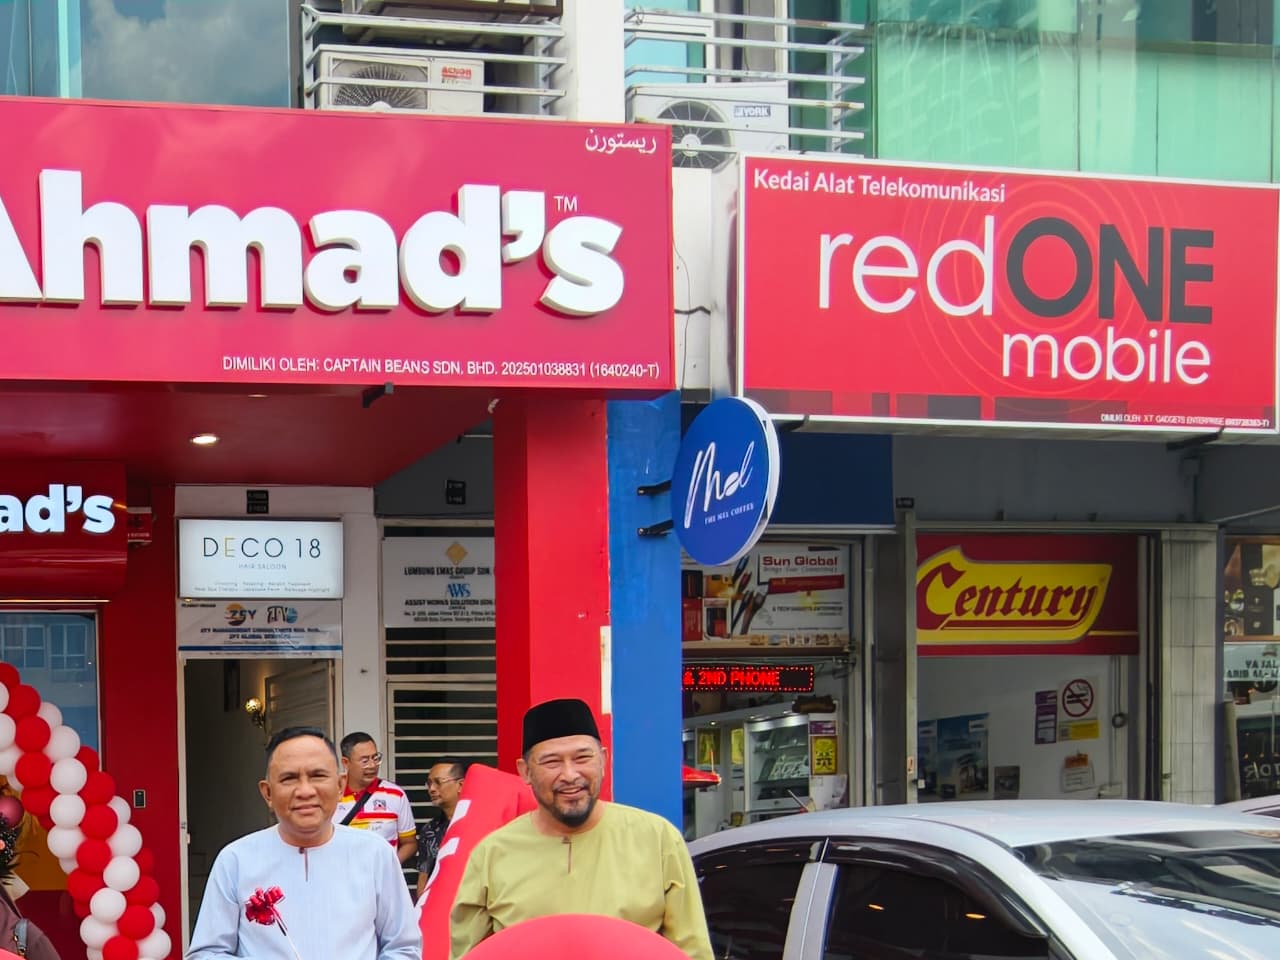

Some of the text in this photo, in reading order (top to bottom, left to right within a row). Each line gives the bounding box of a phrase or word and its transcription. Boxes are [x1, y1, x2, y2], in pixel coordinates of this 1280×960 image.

[753, 168, 1006, 203] Kedai Alat Telekomunikasi
[554, 196, 577, 211] TM
[817, 214, 1215, 325] redONE
[1002, 325, 1211, 385] mobile
[223, 356, 276, 371] DIMILIKI
[279, 357, 320, 373] OLEH:
[323, 358, 381, 373] CAPTAIN
[385, 359, 430, 375] BEANS
[467, 361, 498, 376] BHD.
[501, 362, 586, 377] 202501038831
[590, 363, 659, 378] (1640240-T)
[203, 537, 321, 558] DECO 18
[762, 556, 838, 566] Sun Global
[916, 562, 1098, 631] Century
[698, 671, 726, 684] 2ND
[730, 671, 779, 685] PHONE
